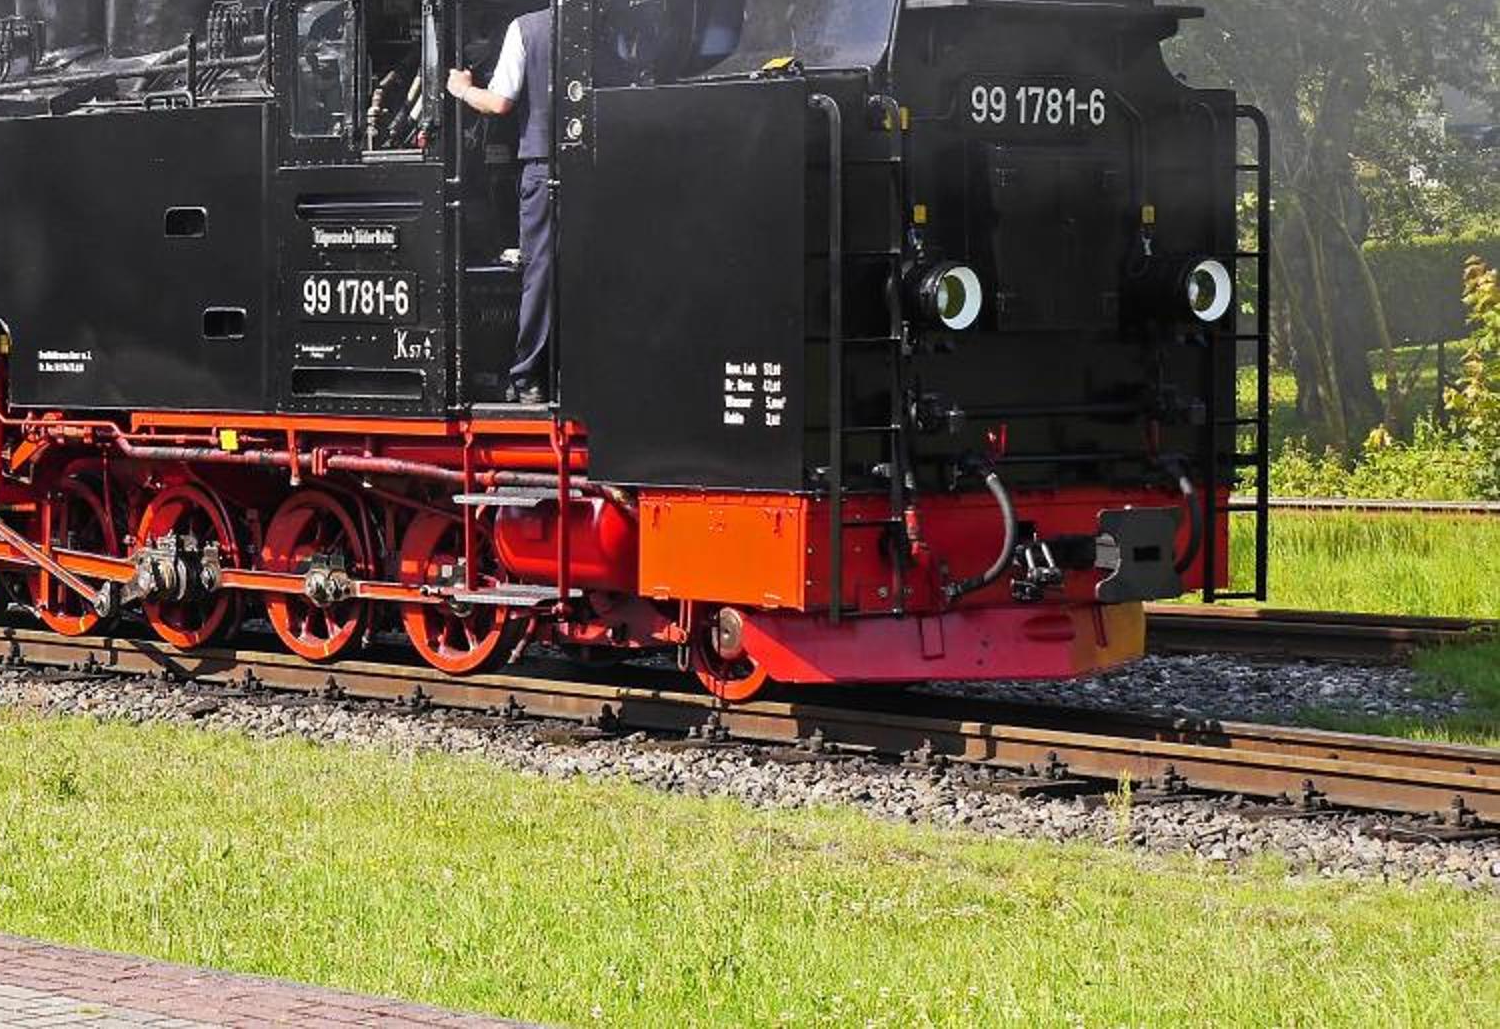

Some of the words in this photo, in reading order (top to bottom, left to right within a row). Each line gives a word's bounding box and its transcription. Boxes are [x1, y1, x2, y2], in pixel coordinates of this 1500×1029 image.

[971, 85, 1007, 124] 99
[1015, 86, 1106, 125] 1781-6
[303, 278, 331, 314] 99
[336, 279, 409, 315] 1781-6
